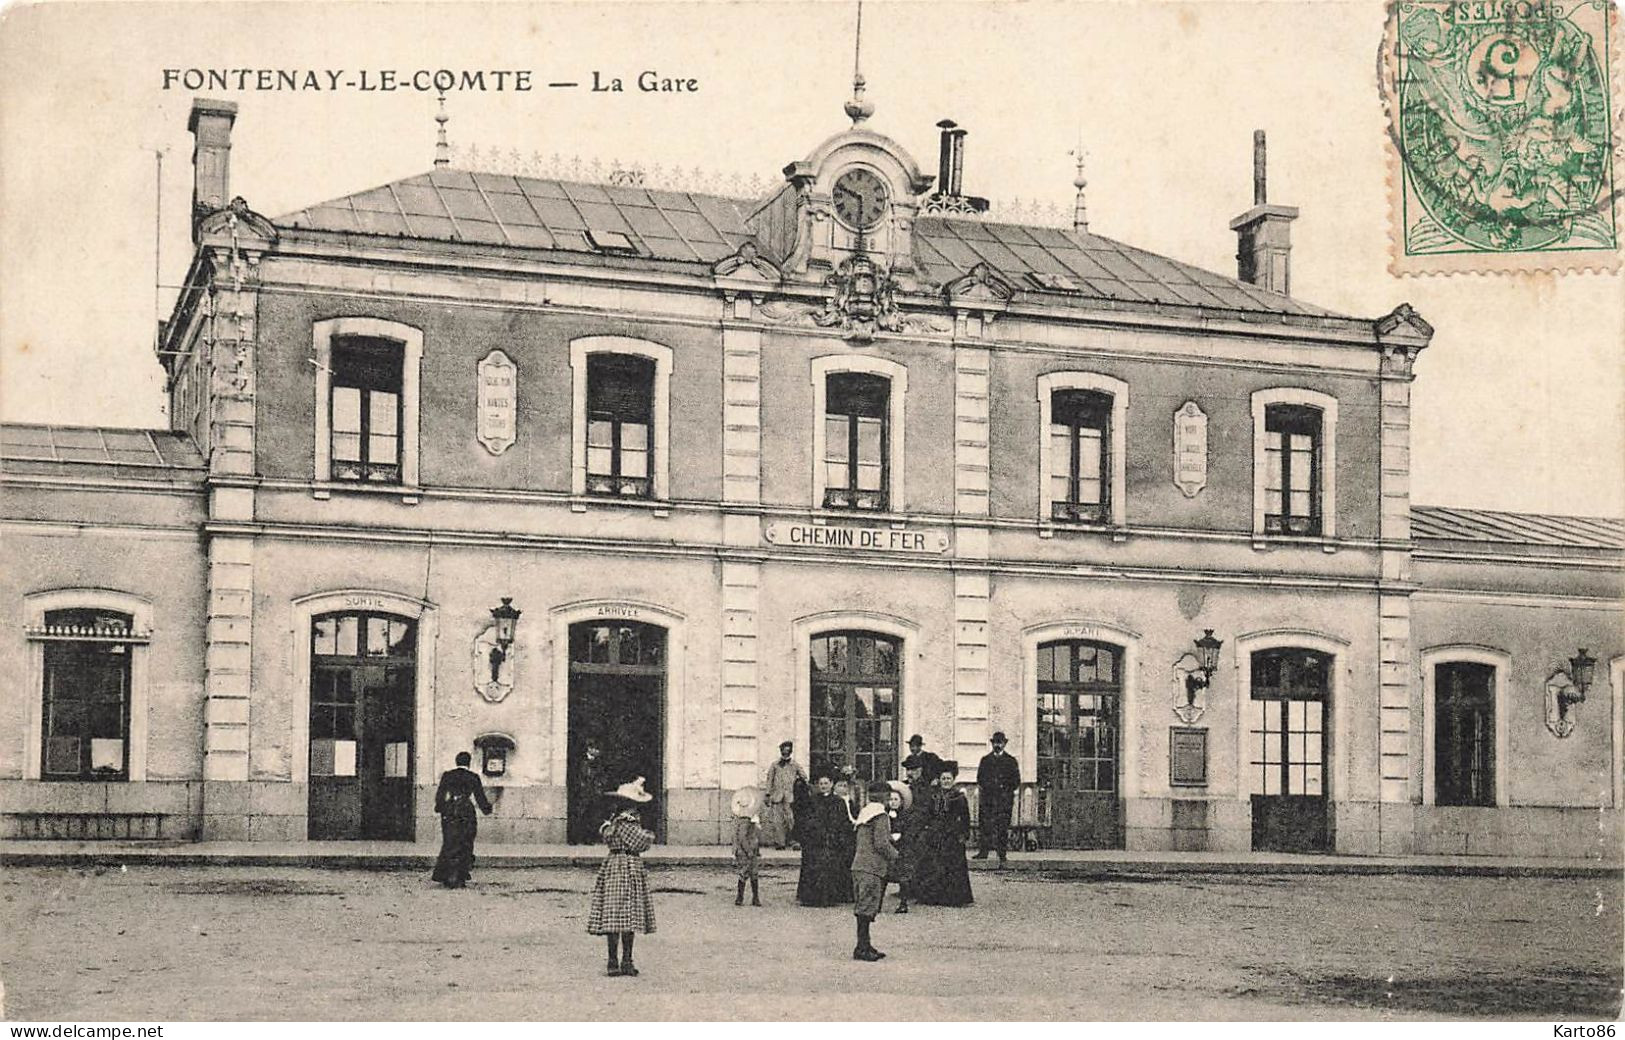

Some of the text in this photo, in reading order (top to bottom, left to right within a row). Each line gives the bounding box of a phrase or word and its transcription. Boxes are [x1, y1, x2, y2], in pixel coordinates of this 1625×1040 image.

[1484, 39, 1520, 100] 5
[790, 527, 925, 550] CHEMIN DE FER
